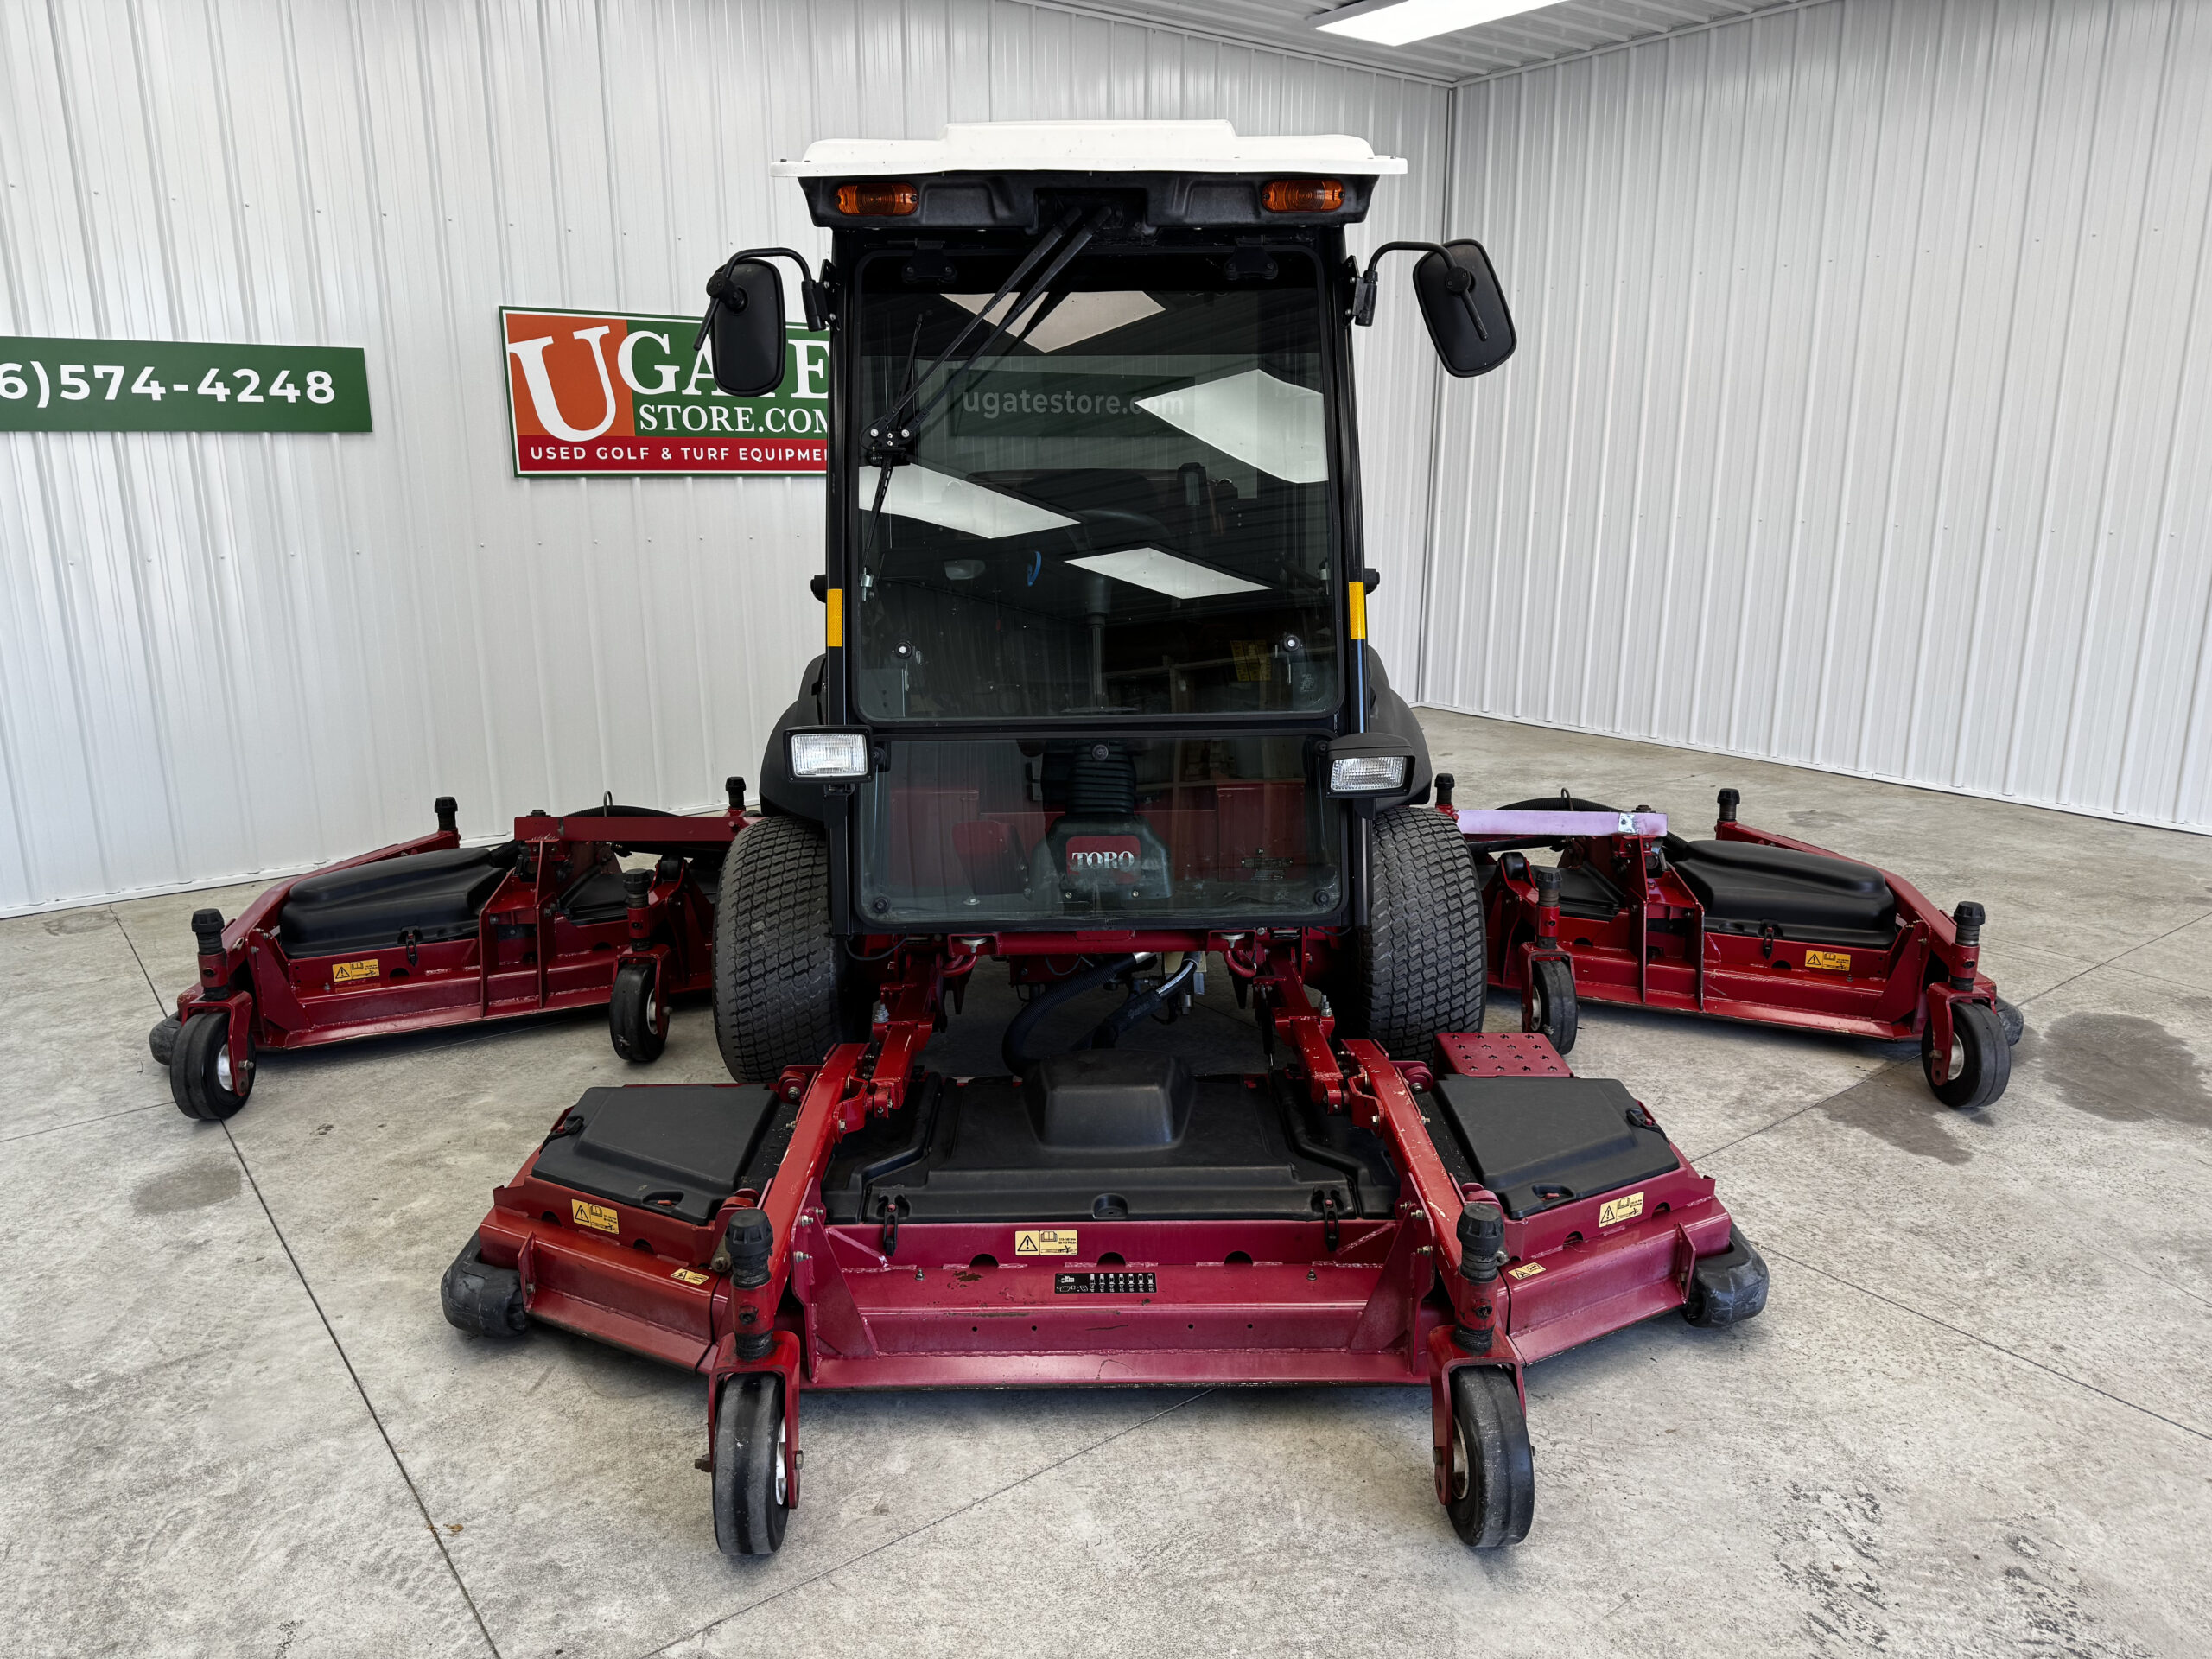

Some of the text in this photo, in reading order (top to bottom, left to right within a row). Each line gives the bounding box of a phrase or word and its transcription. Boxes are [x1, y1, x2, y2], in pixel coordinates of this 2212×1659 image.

[506, 325, 829, 442] UGE
[530, 446, 827, 463] USED GOLF & TURF EQUIPME
[1071, 850, 1135, 870] TORO
